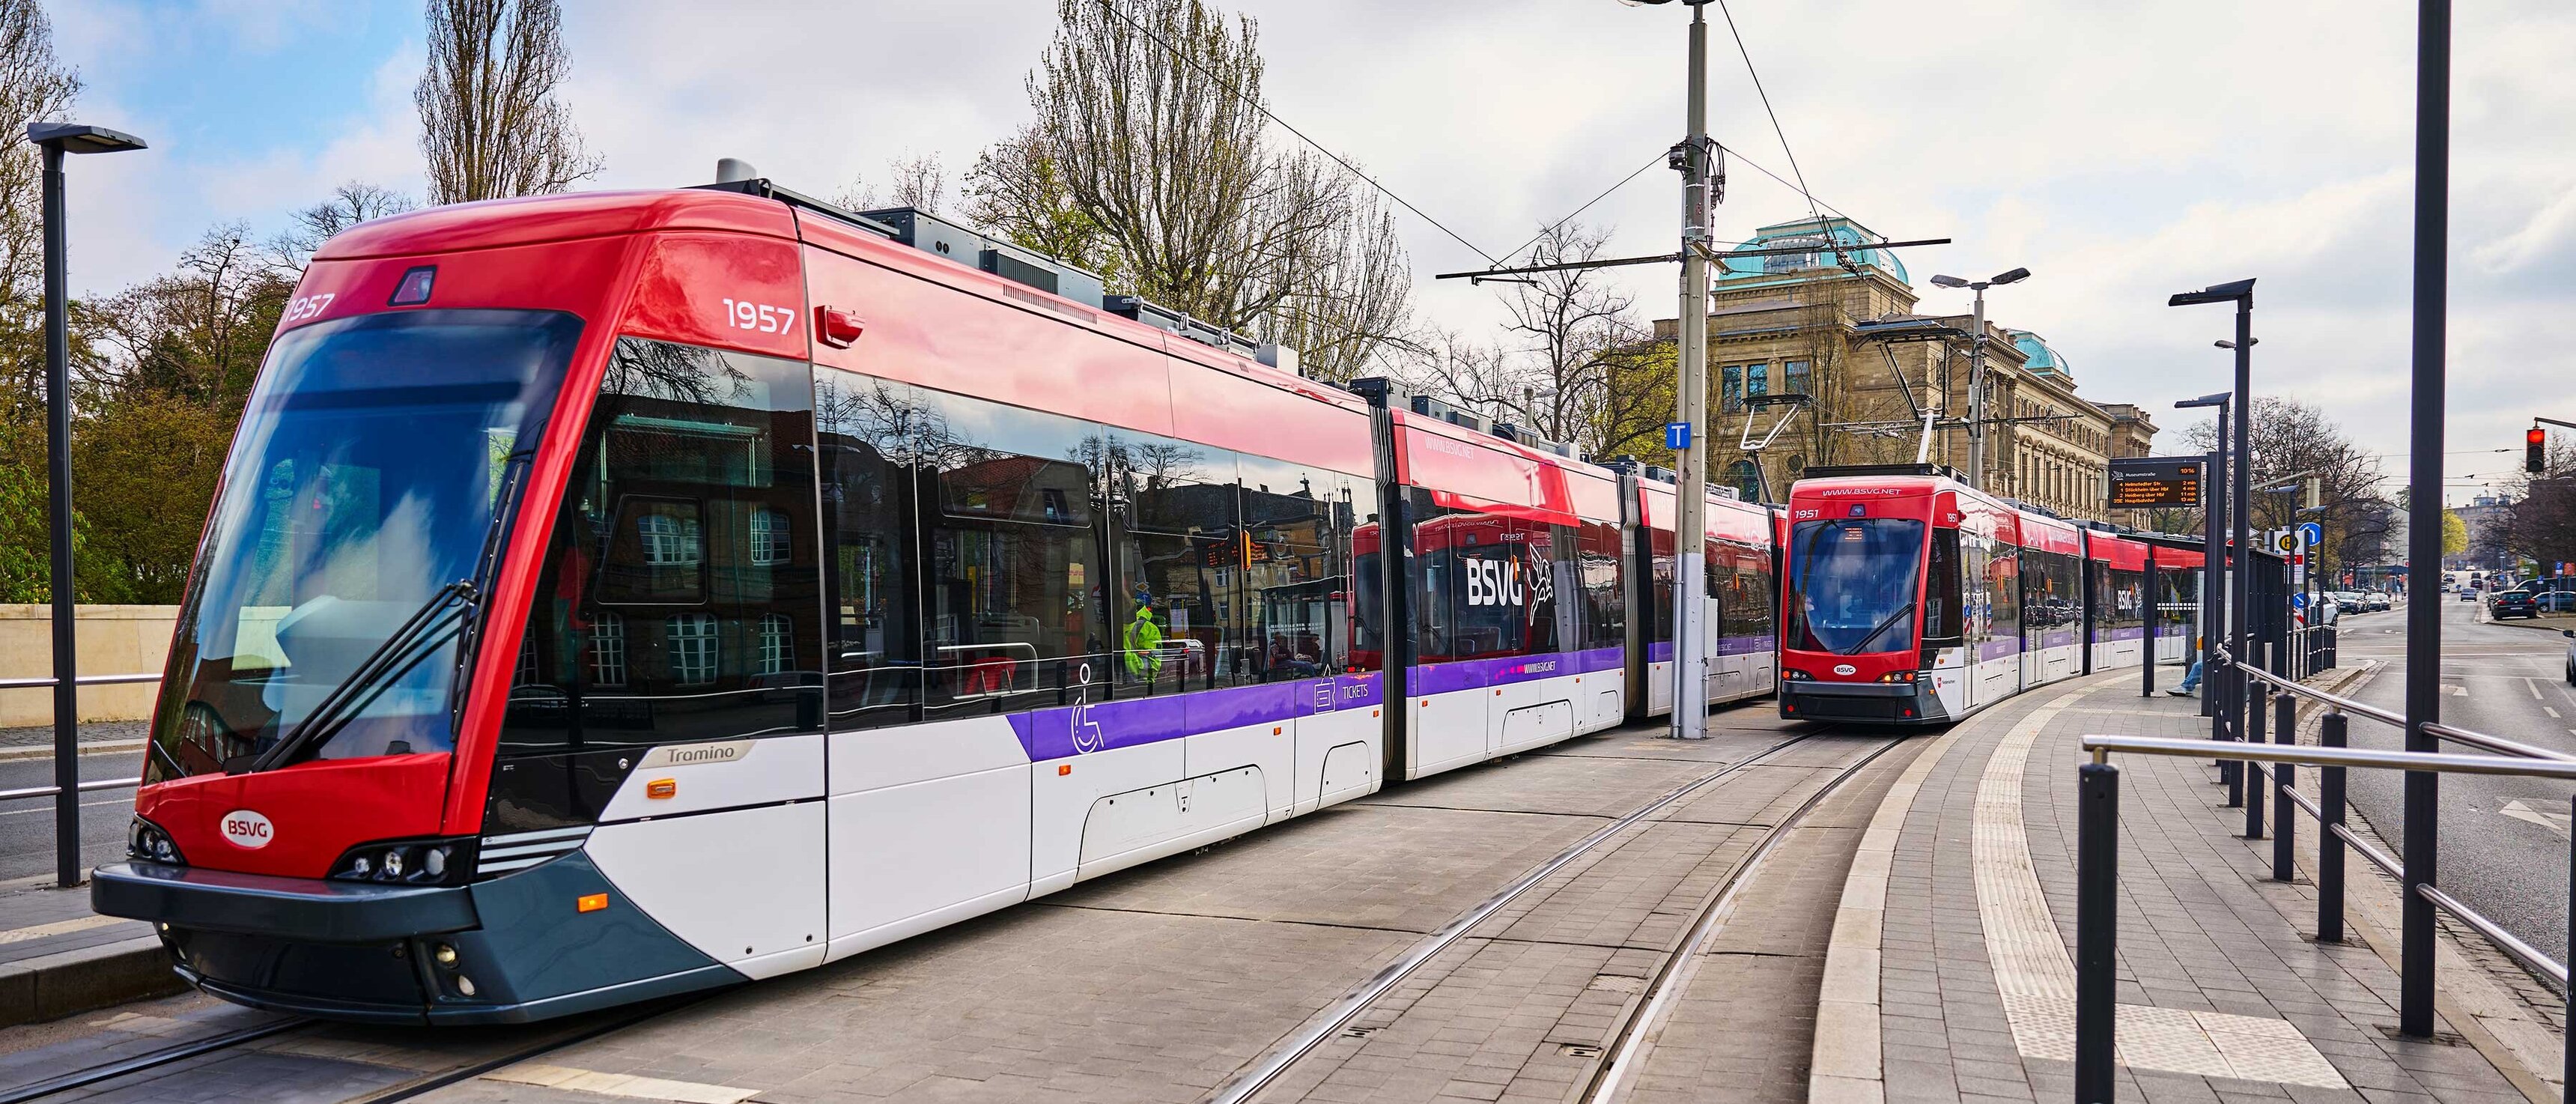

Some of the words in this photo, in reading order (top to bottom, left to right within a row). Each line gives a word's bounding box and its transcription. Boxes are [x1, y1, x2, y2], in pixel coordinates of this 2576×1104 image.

[285, 293, 335, 323] 1957
[723, 298, 795, 336] 1957
[1671, 425, 1686, 446] T
[1425, 436, 1474, 459] WWW.BSVG.NET
[1823, 488, 1902, 497] WWW.BSVG.NET
[1795, 509, 1819, 519] 1951
[1947, 512, 1957, 523] 1951
[1467, 558, 1523, 606] BSVG
[2118, 589, 2133, 610] BSVG
[1524, 661, 1556, 674] WWW.BSVG.NET
[1342, 684, 1369, 700] TICKETS
[667, 747, 735, 763] Tramino
[228, 819, 267, 837] BSVG
